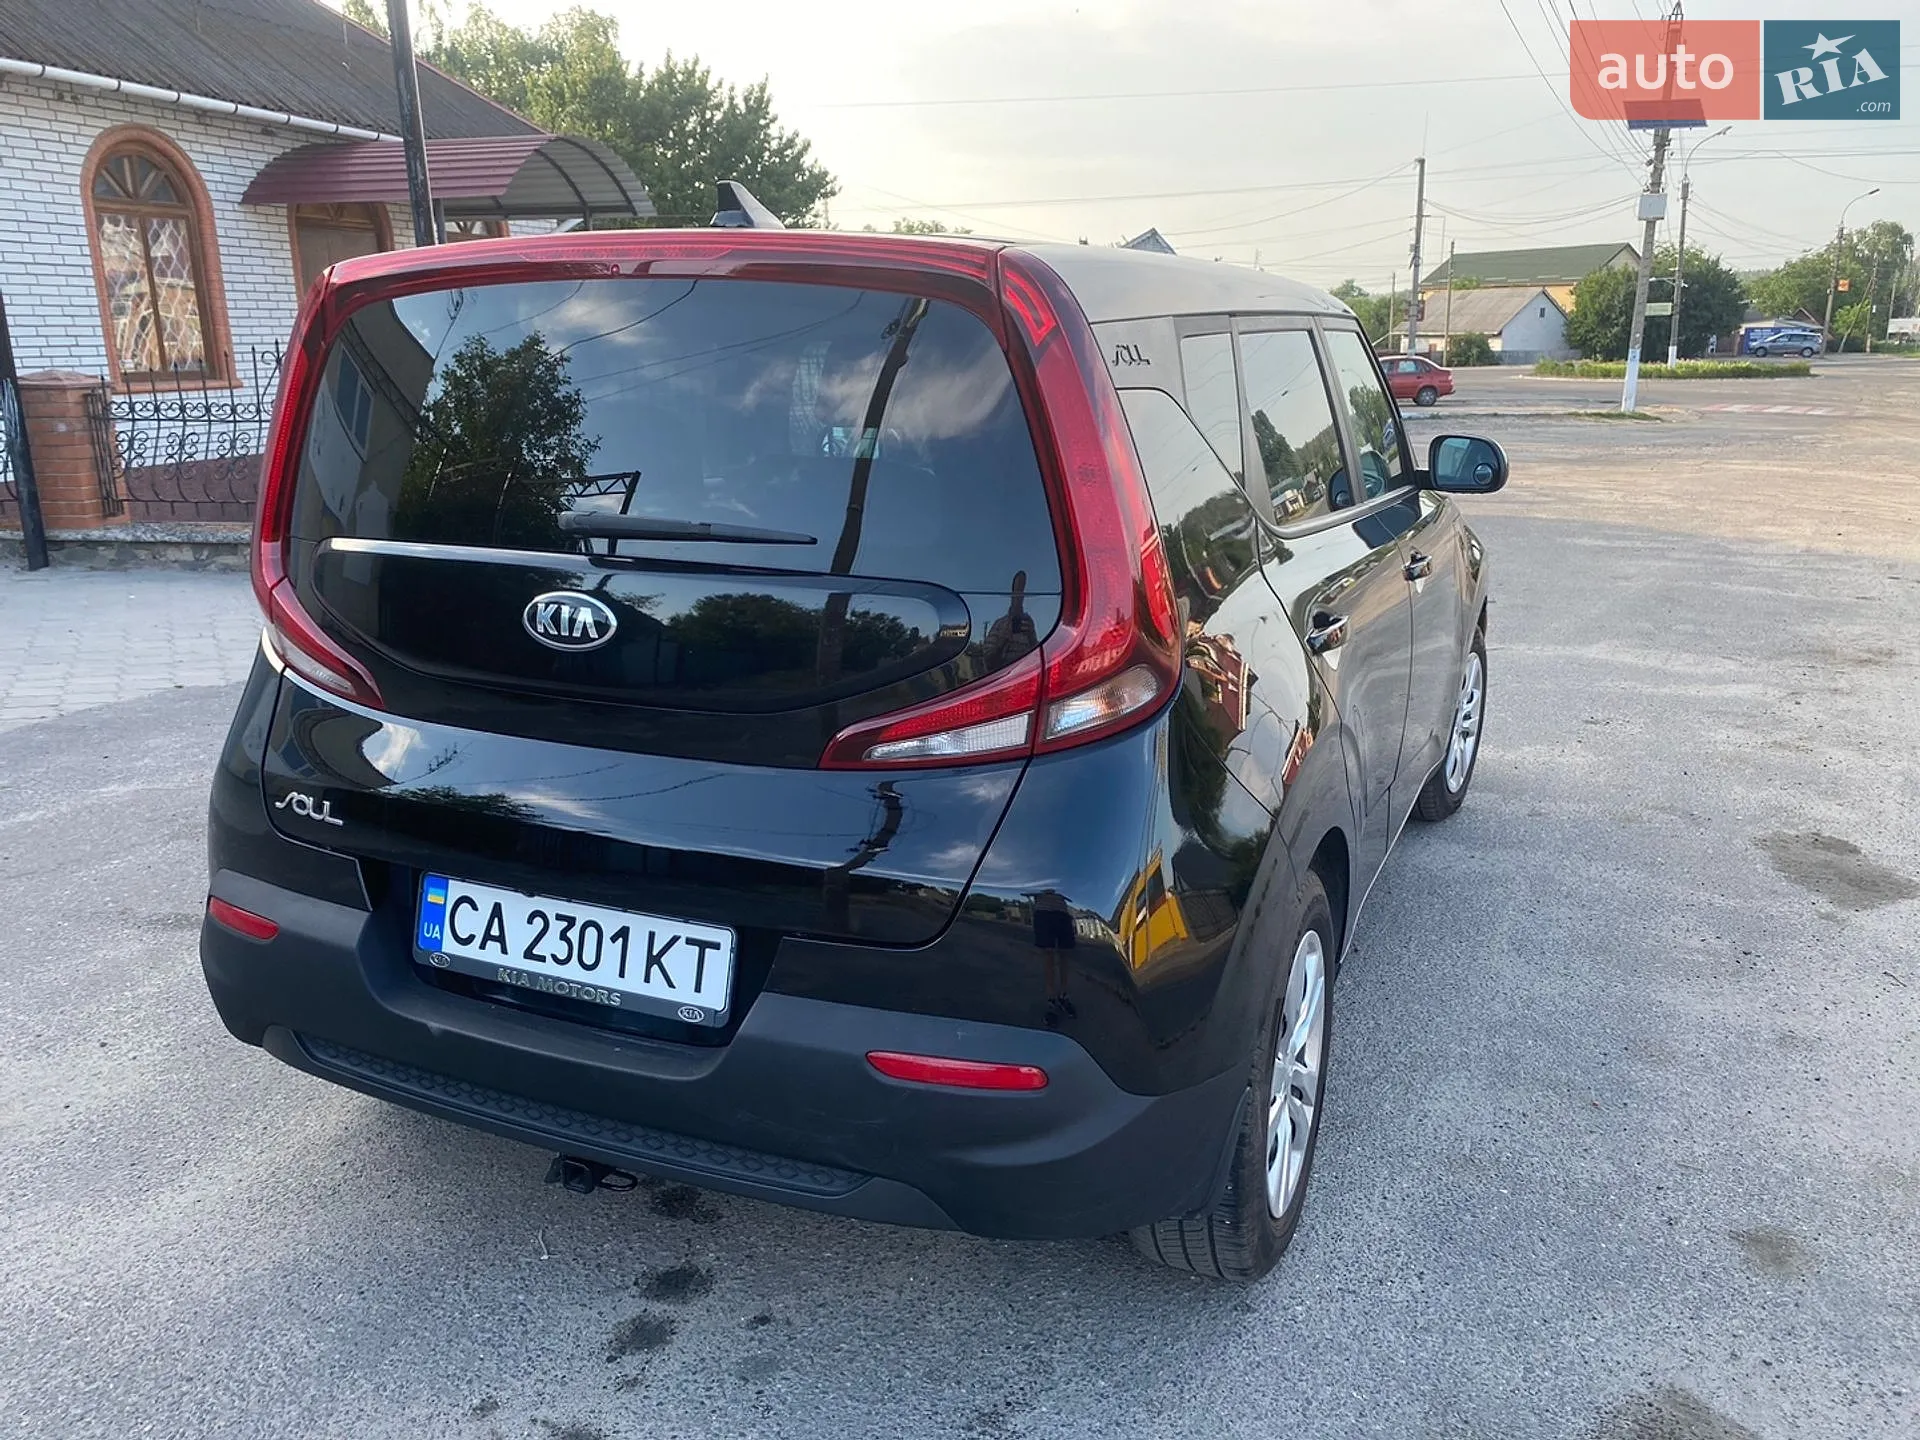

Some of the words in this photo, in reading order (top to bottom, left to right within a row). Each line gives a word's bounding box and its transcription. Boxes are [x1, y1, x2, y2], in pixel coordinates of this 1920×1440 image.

[536, 602, 600, 639] KIA
[275, 791, 344, 827] SOUL
[423, 921, 441, 941] UA
[448, 895, 509, 956] CA
[522, 909, 631, 979] 2301
[643, 930, 721, 994] KT
[497, 967, 531, 988] KIA
[536, 976, 622, 1007] MOTORS
